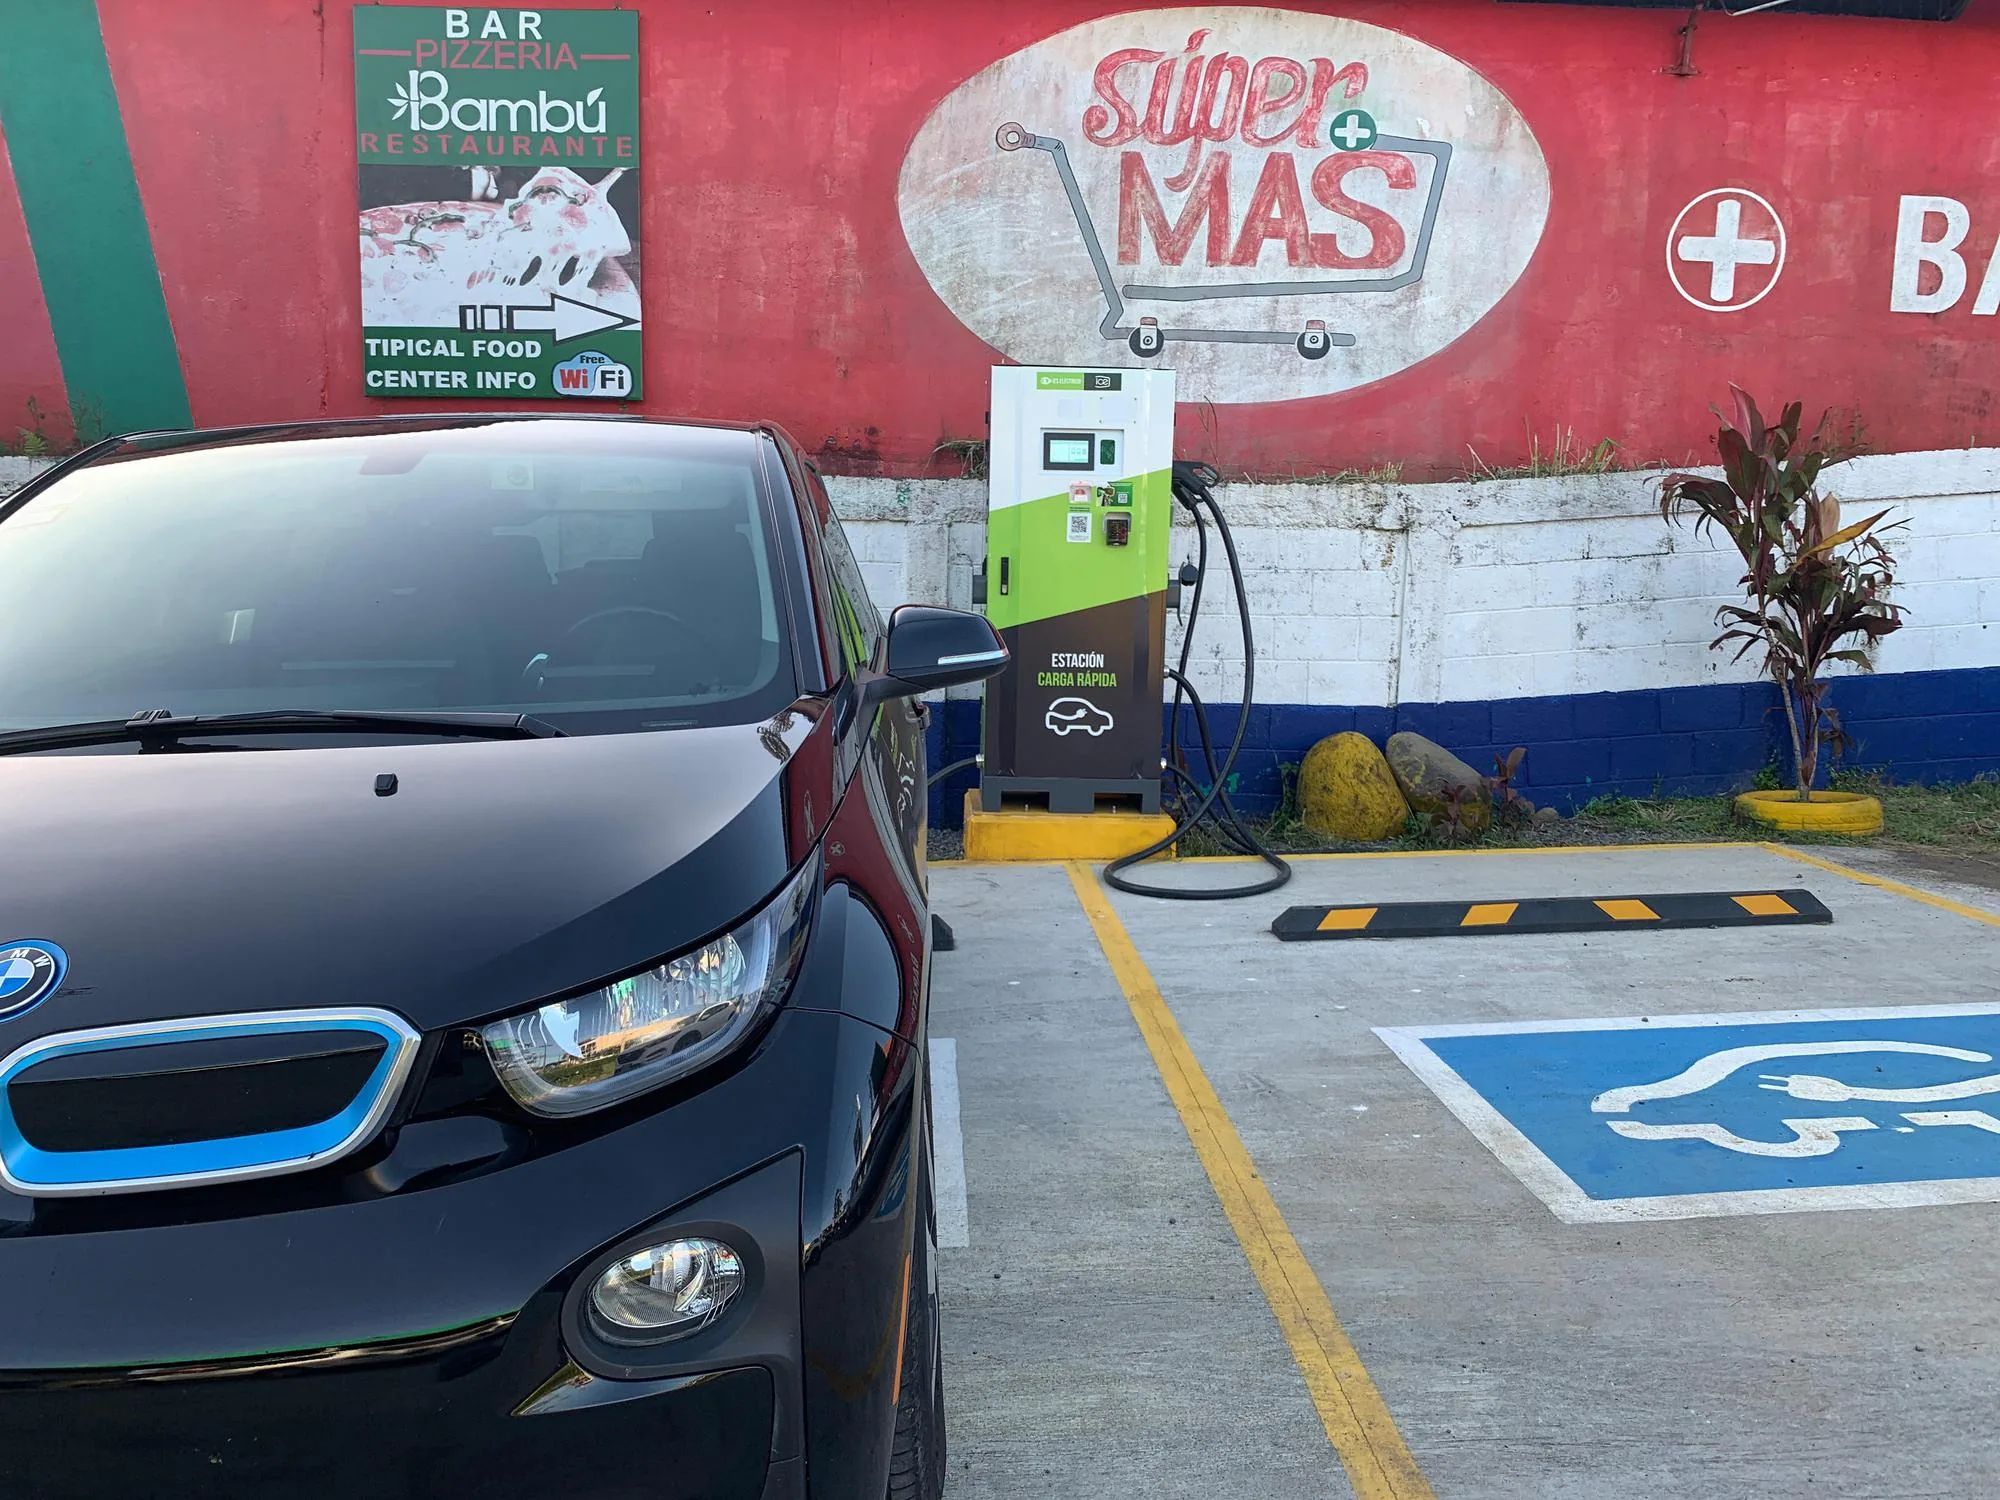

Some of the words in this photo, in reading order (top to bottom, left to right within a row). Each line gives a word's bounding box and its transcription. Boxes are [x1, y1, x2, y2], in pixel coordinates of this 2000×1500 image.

[445, 9, 543, 40] BAR
[415, 39, 578, 70] PIZZERIA
[408, 69, 606, 133] Bambú
[360, 132, 633, 158] RESTAURANTE
[1117, 151, 1417, 270] MAS
[365, 338, 465, 357] TIPICAL
[472, 340, 542, 359] FOOD
[579, 354, 606, 365] Free
[366, 370, 469, 389] CENTER
[476, 371, 537, 390] INFO
[1051, 651, 1105, 668] ESTACIÓN
[1037, 671, 1075, 687] CARGA
[1077, 670, 1118, 688] RÁPIDA
[9, 949, 51, 968] MW
